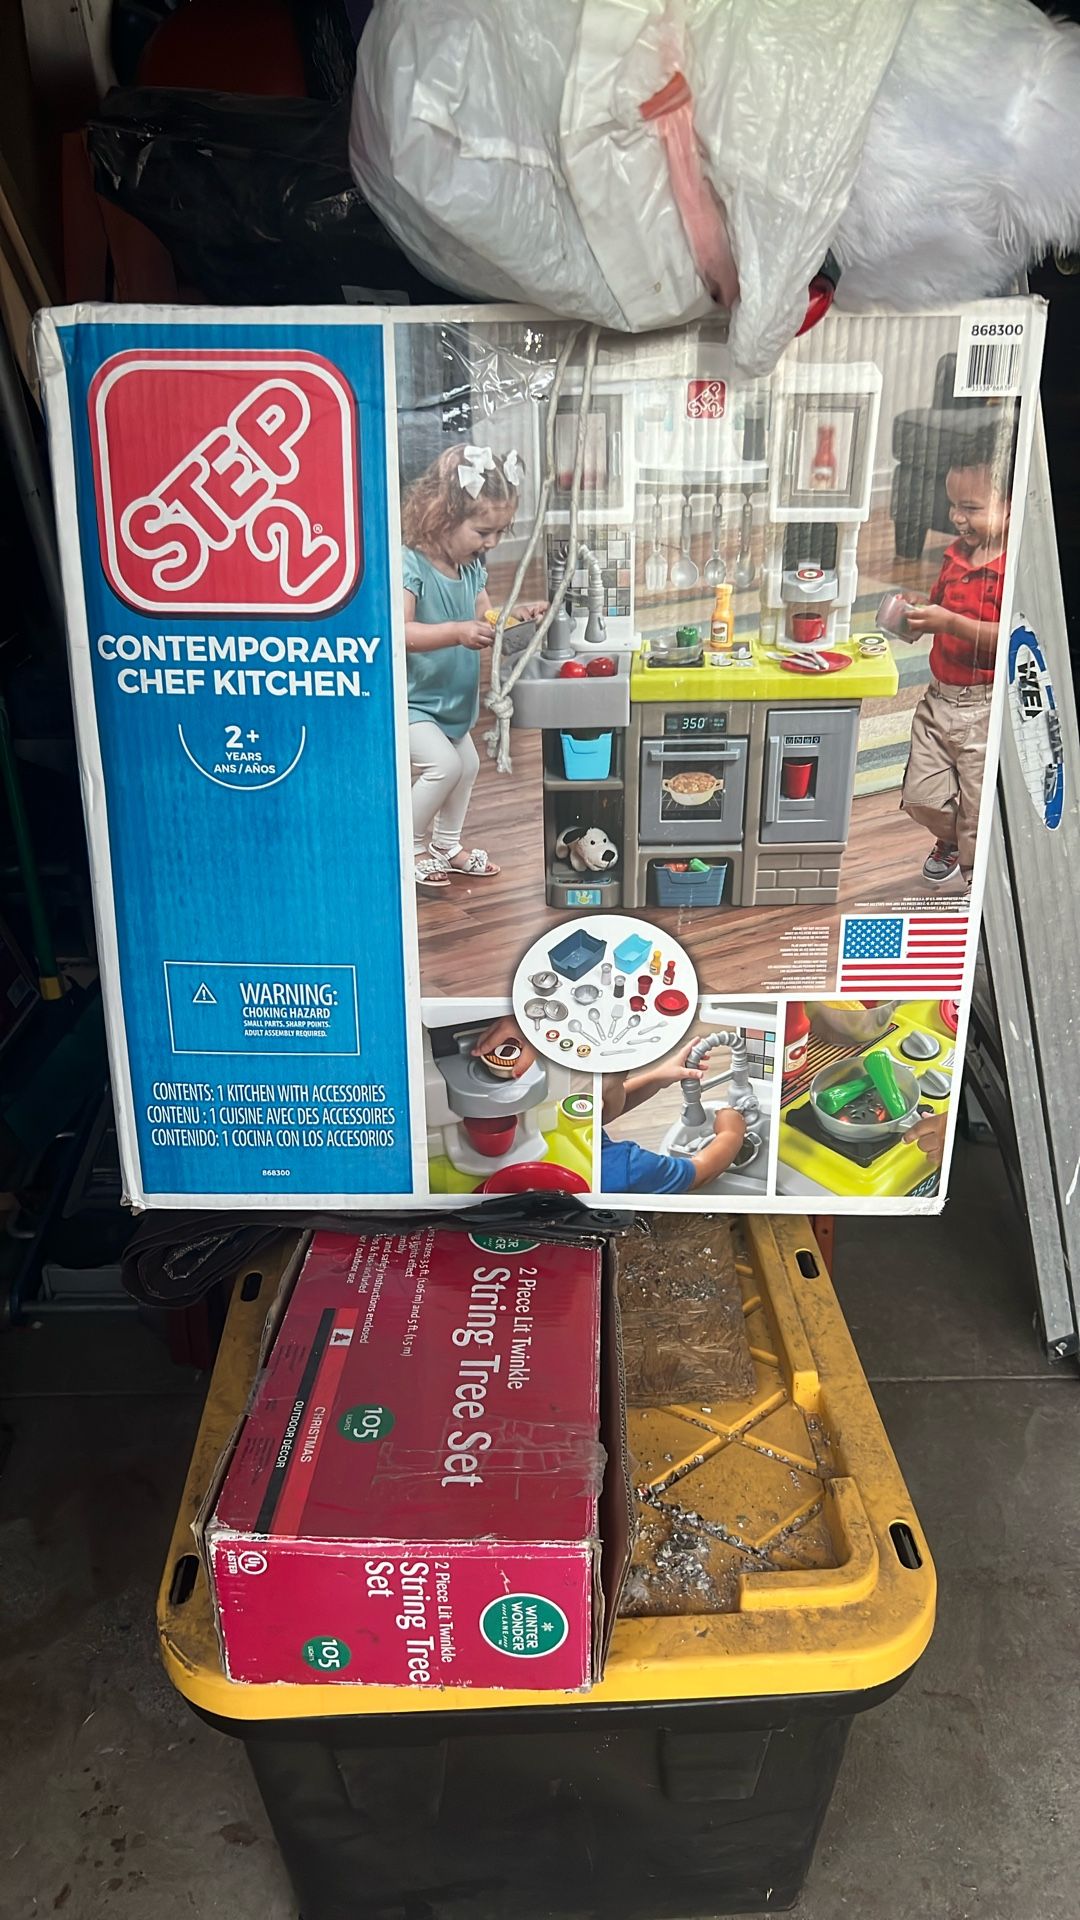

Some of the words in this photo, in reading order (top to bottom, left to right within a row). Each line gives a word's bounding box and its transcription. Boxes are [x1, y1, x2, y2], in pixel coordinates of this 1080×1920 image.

[971, 324, 1024, 336] 868300
[687, 382, 720, 417] STEP
[708, 400, 724, 417] 2
[120, 378, 311, 592] STEP
[97, 634, 381, 664] CONTEMPORARY
[117, 668, 205, 695] CHEF
[213, 763, 237, 774] ANS
[244, 762, 276, 774] AÑOS
[225, 751, 262, 762] YEARS
[239, 982, 339, 1006] WARNING:
[242, 1006, 287, 1018] CHOKING
[289, 1007, 331, 1019] HAZARD
[243, 1019, 264, 1027] SMALL
[264, 1020, 285, 1028] PARTS.
[285, 1020, 306, 1028] SHARP
[264, 1029, 294, 1037] ASSEMBLY
[153, 1082, 215, 1102] CONTENTS:
[217, 1084, 224, 1102] 1
[227, 1084, 275, 1102] KITCHEN
[277, 1084, 309, 1102] WITH
[312, 1084, 386, 1102] ACCESSORIES
[147, 1105, 200, 1124] CONTENU
[209, 1107, 216, 1124] 1
[219, 1107, 264, 1125] CUISINE
[266, 1107, 295, 1125] AVEC
[297, 1107, 320, 1125] DES
[322, 1107, 395, 1125] ACCESSOIRES
[151, 1128, 220, 1147] CONTENIDO:
[222, 1130, 228, 1147] 1
[231, 1130, 274, 1147] COCINA
[276, 1130, 300, 1147] CON
[302, 1130, 324, 1147] LOS
[326, 1130, 395, 1147] ACCESORIOS
[262, 1169, 291, 1177] 868300
[350, 1247, 364, 1272] outdoor
[383, 1241, 392, 1253] and
[375, 1253, 390, 1272] safety
[518, 1266, 538, 1275] 2
[367, 1273, 387, 1312] instructions
[451, 1265, 511, 1346] String
[515, 1279, 537, 1313] Piece
[410, 1305, 420, 1318] and
[513, 1316, 534, 1333] Lit
[359, 1312, 374, 1343] enclosed
[507, 1336, 532, 1390] Twinkle
[452, 1354, 501, 1419] Tree
[284, 1400, 305, 1439] OUTDOOR
[353, 1407, 383, 1439] 105
[300, 1406, 326, 1463] CHRISTMAS
[275, 1439, 293, 1468] DÉCOR
[441, 1430, 492, 1488] Set
[364, 1560, 395, 1598] Set
[434, 1561, 449, 1570] 2
[395, 1561, 431, 1630] String
[435, 1572, 451, 1603] Piece
[437, 1605, 452, 1619] Lit
[501, 1616, 509, 1635] LANE
[511, 1601, 525, 1651] WONDER
[525, 1604, 539, 1649] WINTER
[318, 1639, 340, 1668] 105
[438, 1622, 456, 1663] Twinkle
[406, 1636, 435, 1683] Tree
